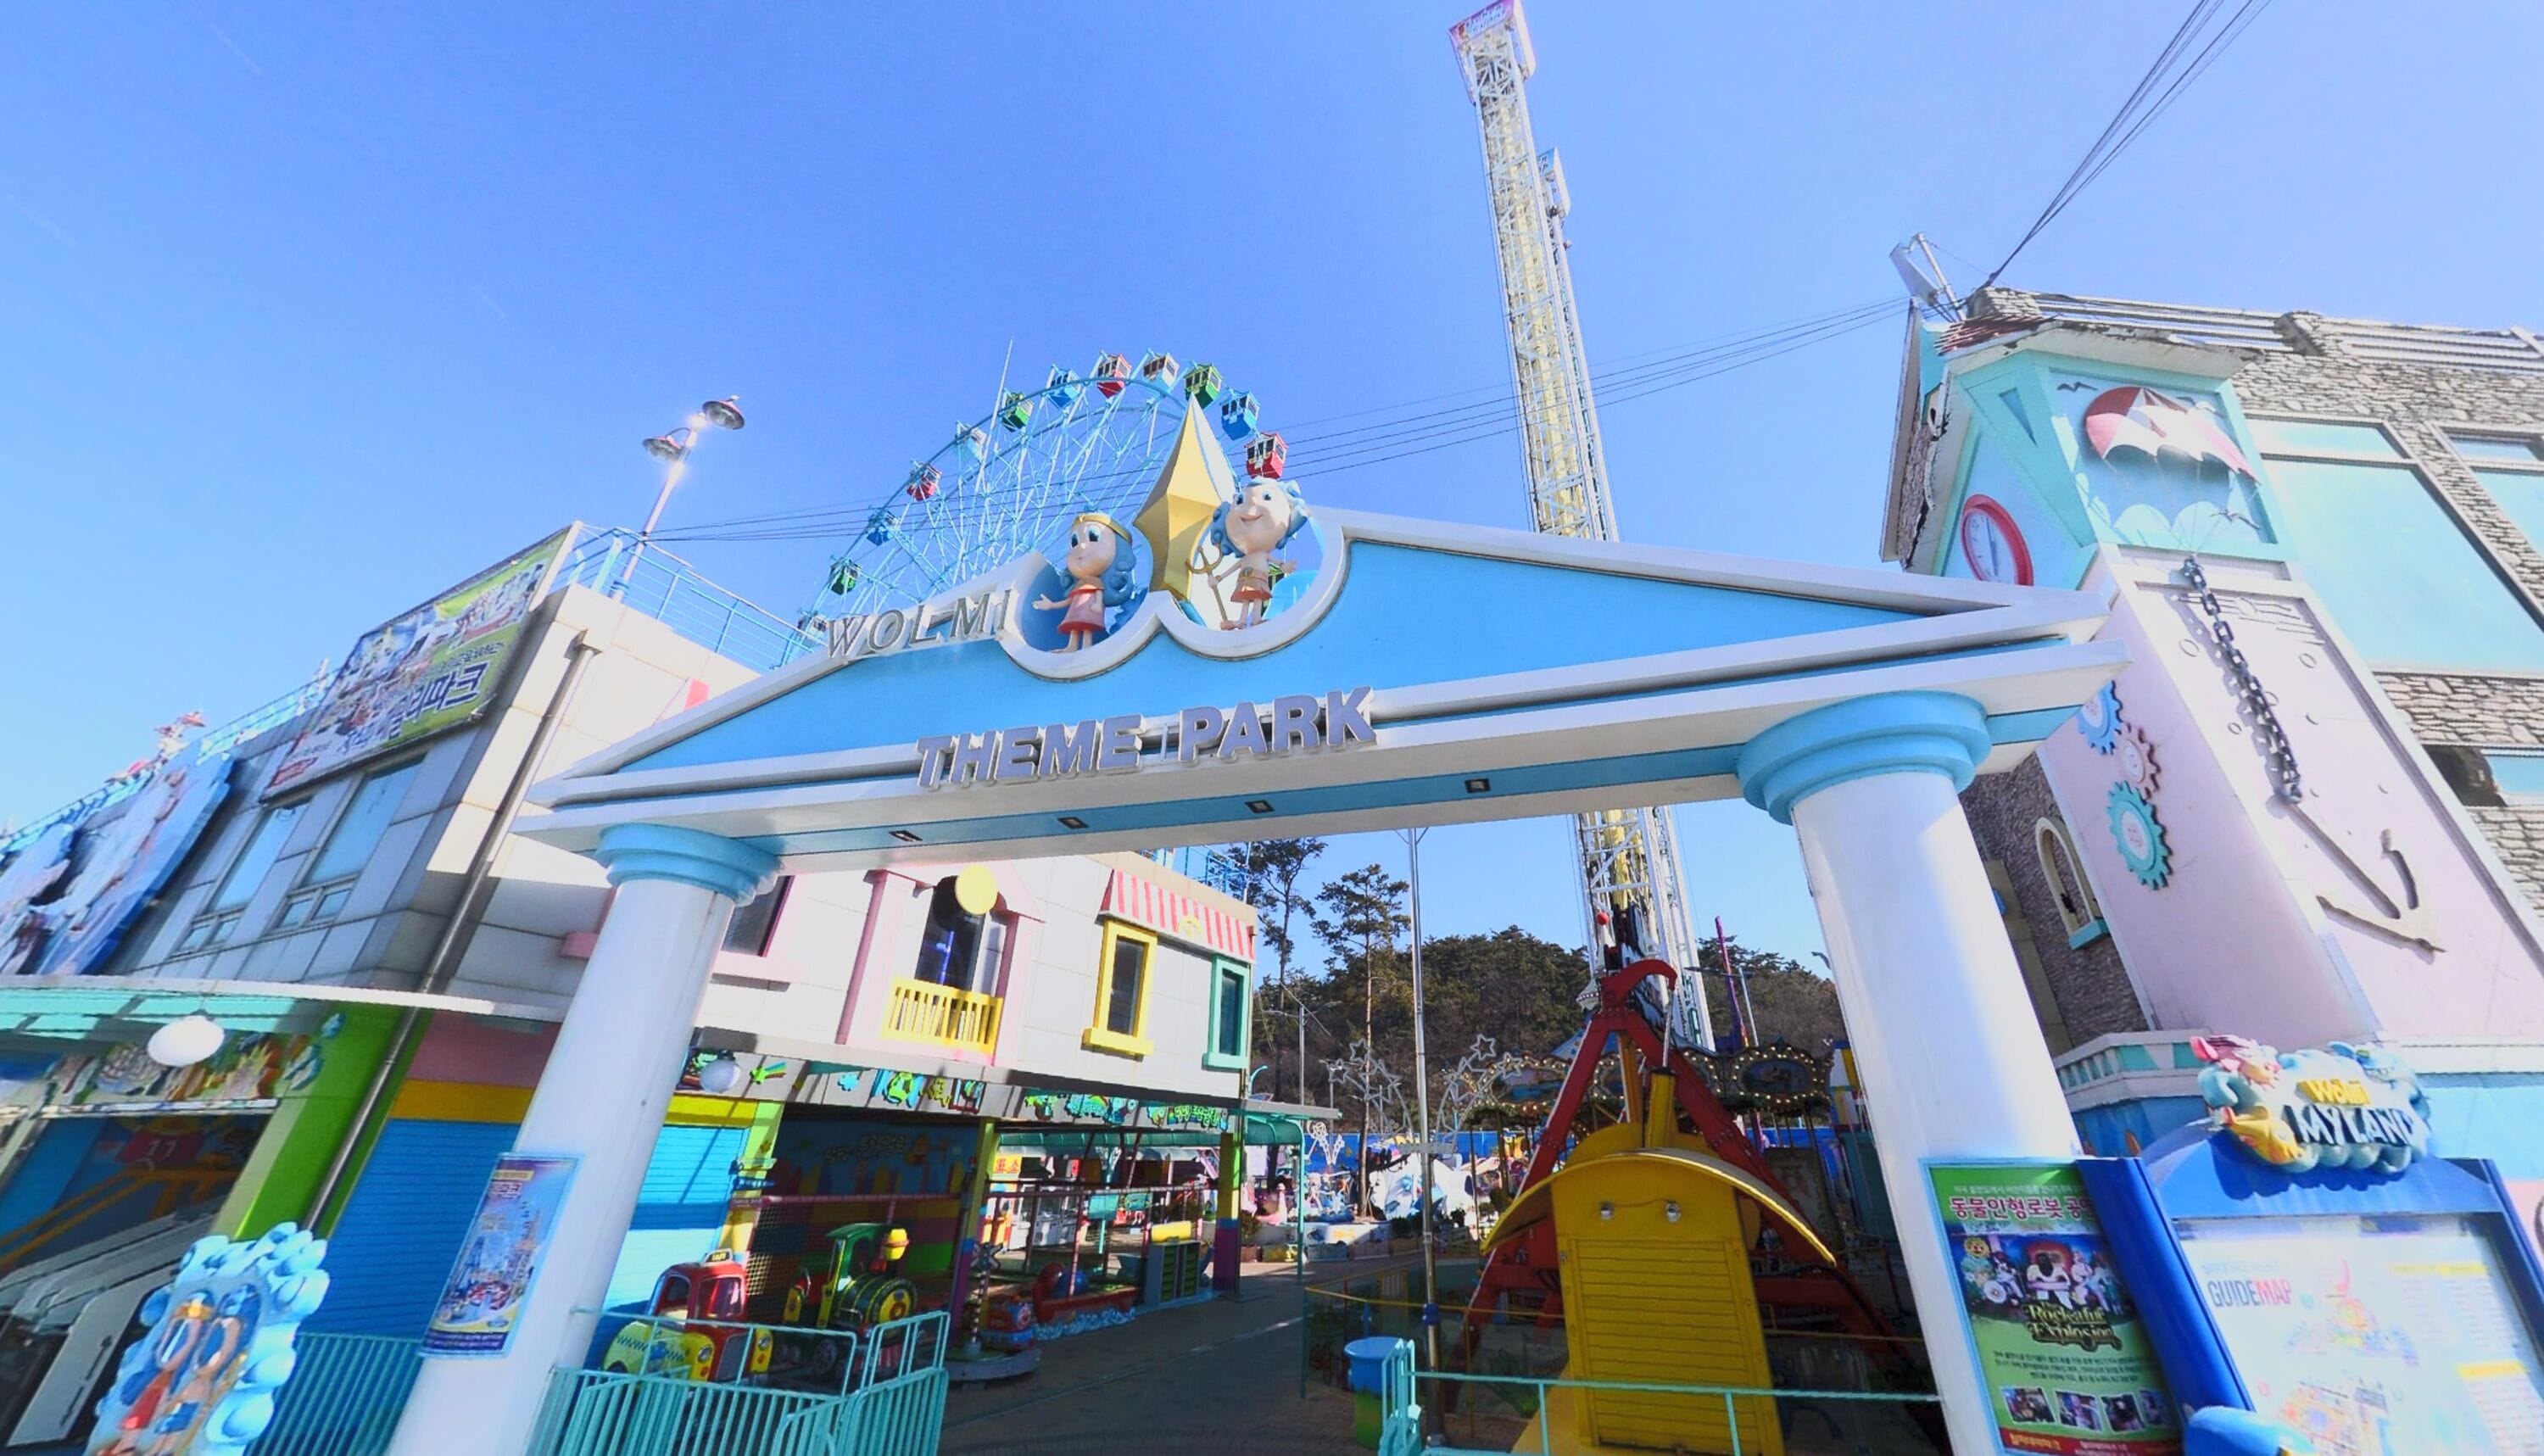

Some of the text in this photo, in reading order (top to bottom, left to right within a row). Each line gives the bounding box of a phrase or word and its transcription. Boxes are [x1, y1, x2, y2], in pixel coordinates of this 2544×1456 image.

[828, 589, 1014, 660] WOLMI
[917, 685, 1377, 789] THEME PARK
[2288, 1103, 2416, 1146] MYLAND
[1950, 1197, 2065, 1220] 동물인형로봇
[2206, 1277, 2292, 1308] GUIDEMAP
[2028, 1321, 2114, 1342] Explosion
